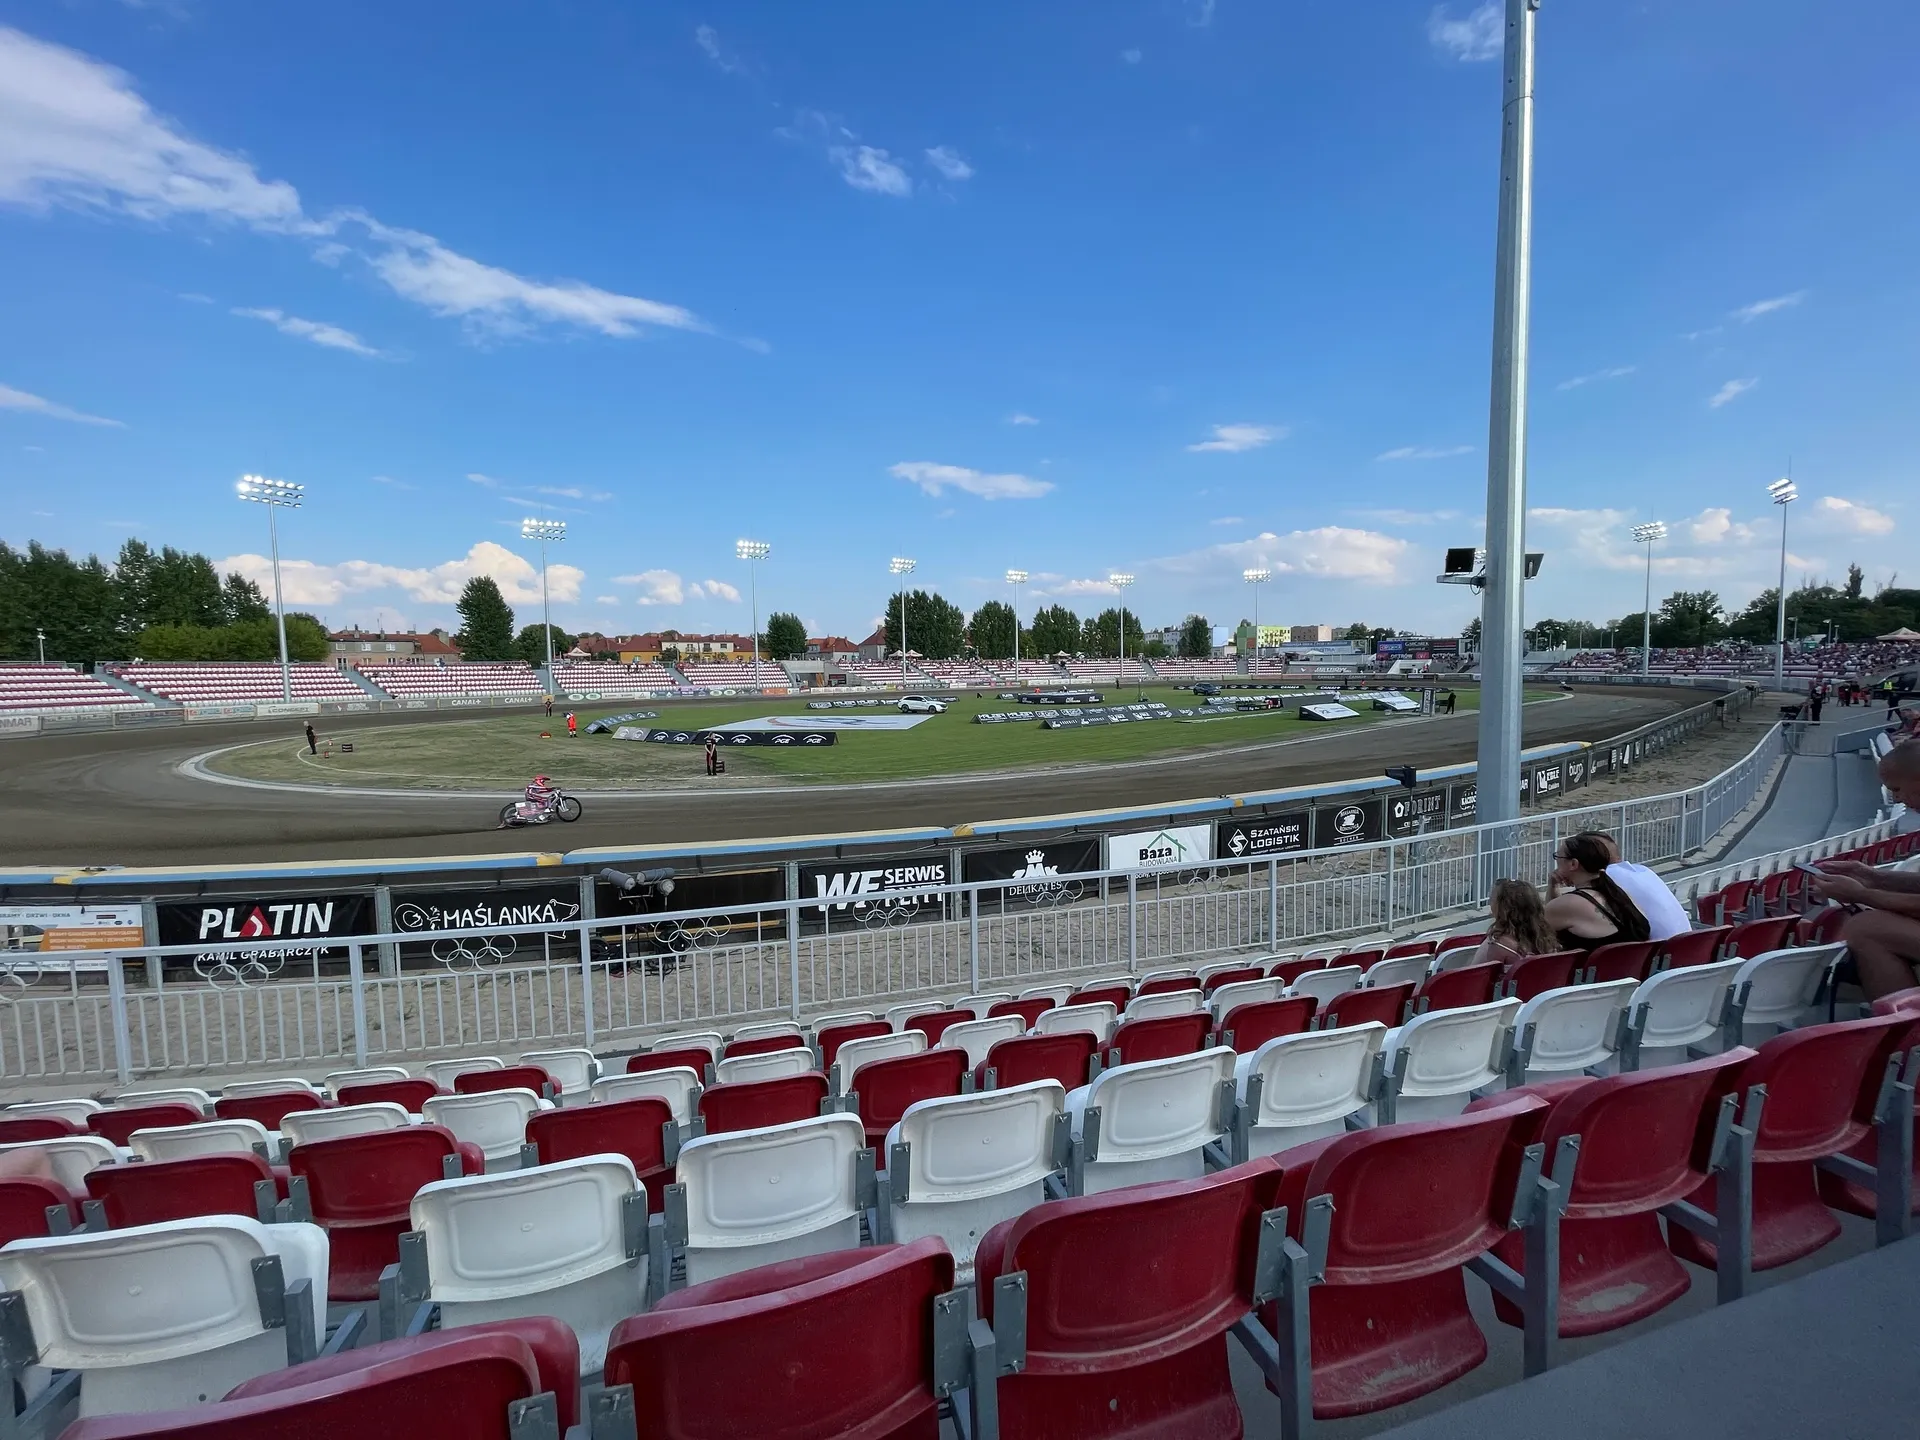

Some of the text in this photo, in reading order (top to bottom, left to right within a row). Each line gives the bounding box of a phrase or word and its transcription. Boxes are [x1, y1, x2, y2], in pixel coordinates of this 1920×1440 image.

[1250, 824, 1300, 838] SZATAŃSKI
[1250, 833, 1300, 849] LOGISTIK
[1139, 847, 1173, 861] Baza
[884, 864, 946, 885] SERWIS
[199, 902, 334, 940] PLATIN
[443, 902, 556, 929] MAŚLANKA
[197, 949, 238, 962] KAMIL
